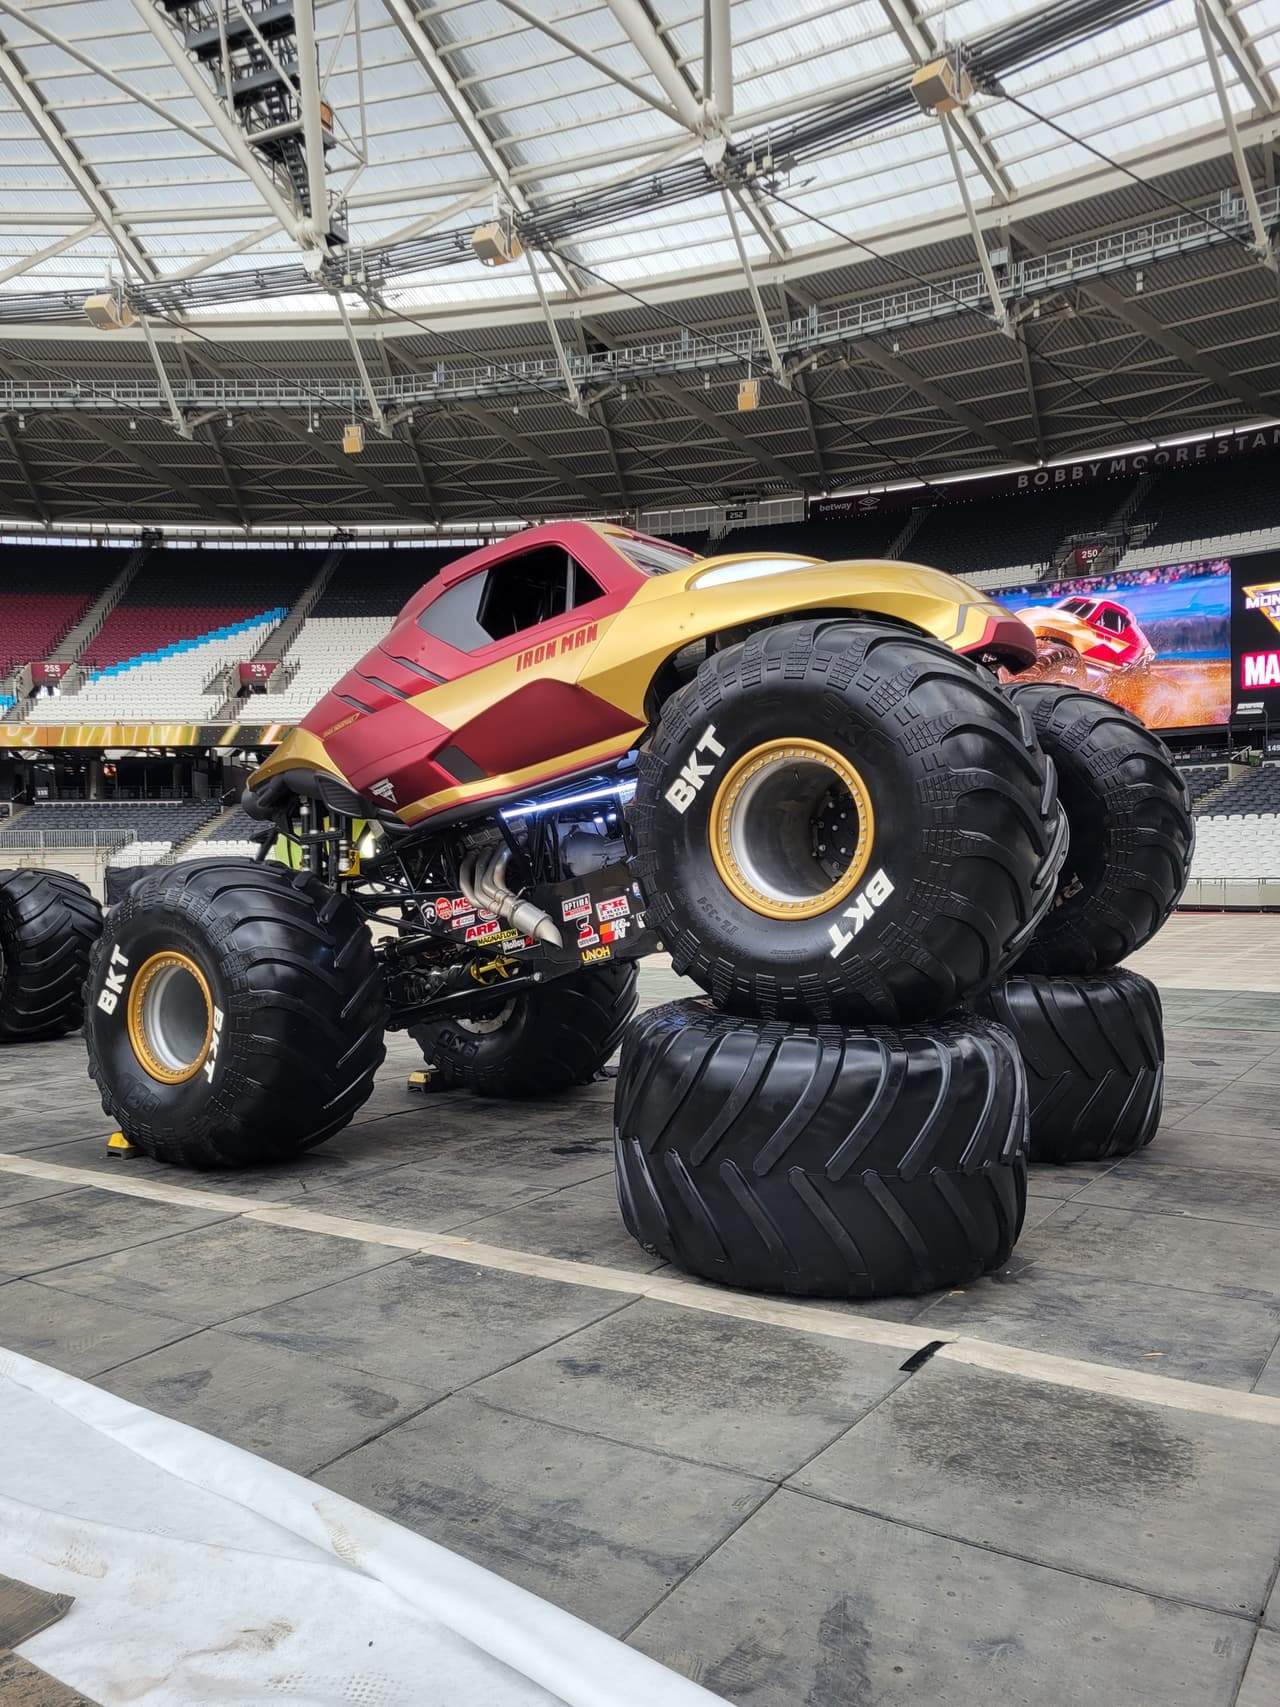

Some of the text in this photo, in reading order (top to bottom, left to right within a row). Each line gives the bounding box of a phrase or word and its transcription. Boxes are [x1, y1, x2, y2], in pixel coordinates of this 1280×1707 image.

[1017, 463, 1100, 489] BOBBY
[1110, 444, 1207, 474] MOORE
[819, 502, 852, 512] betway
[1081, 549, 1098, 559] 250
[516, 623, 598, 672] IRON MAN
[44, 664, 60, 673] 255
[251, 664, 266, 673] 254
[664, 724, 726, 814] BKT
[564, 897, 589, 912] OPTIMA
[828, 868, 895, 958] BKT
[467, 921, 498, 939] ARP
[479, 929, 518, 945] MAGNAFLOW
[503, 939, 525, 951] Holley
[582, 945, 610, 961] UNOH
[97, 944, 131, 1016] BKT
[204, 1005, 225, 1084] BKT
